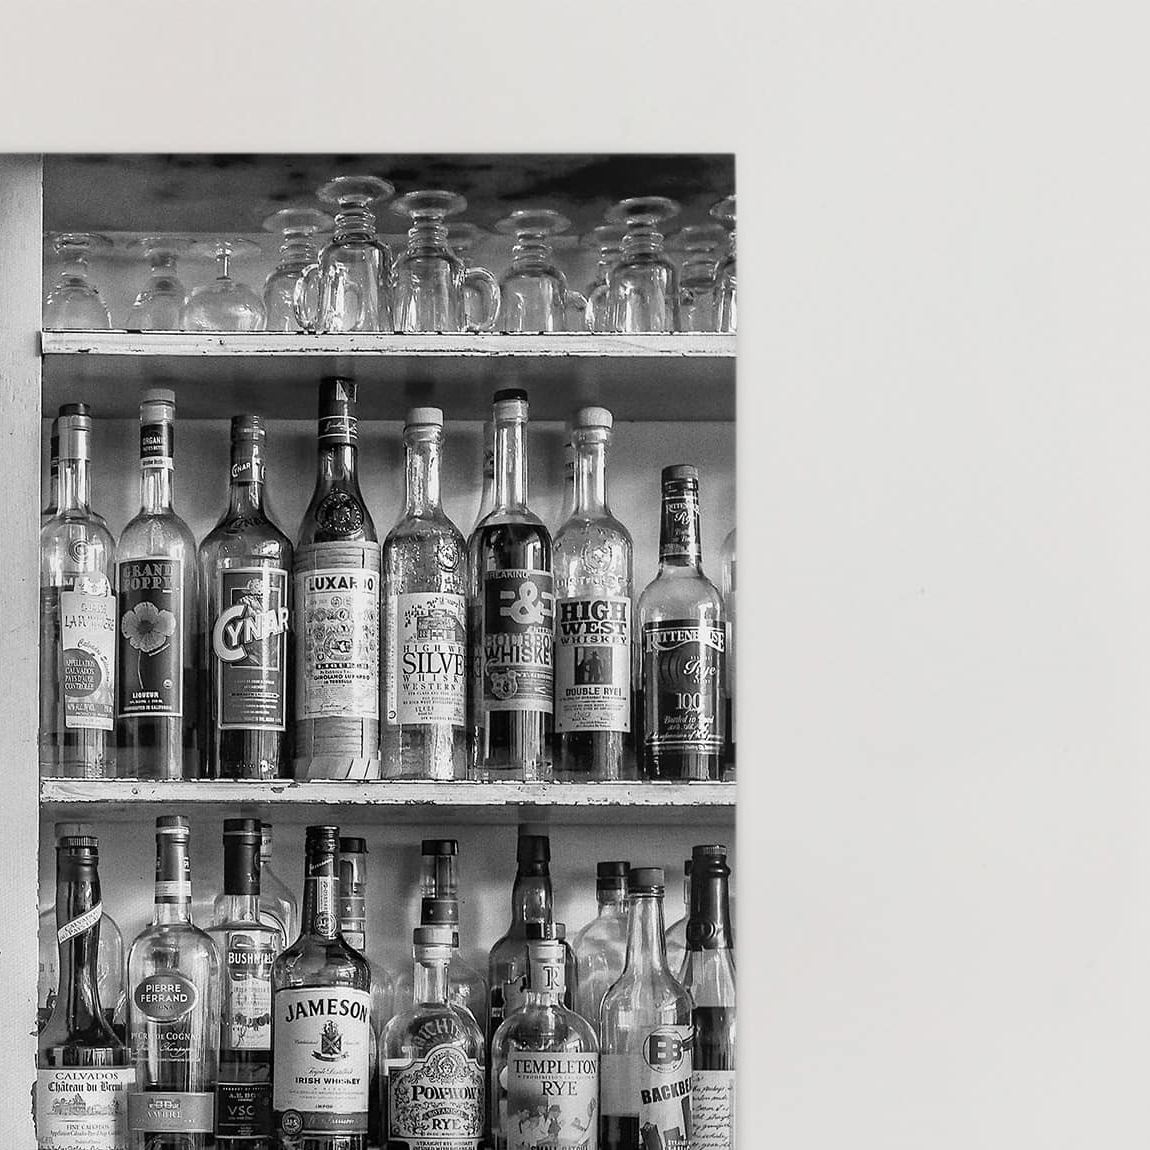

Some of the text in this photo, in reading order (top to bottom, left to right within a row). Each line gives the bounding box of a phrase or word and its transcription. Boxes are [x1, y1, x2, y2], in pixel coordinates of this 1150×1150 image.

[123, 563, 174, 578] GRAND
[309, 576, 374, 592] LUXARO
[560, 600, 627, 622] HIGH
[212, 603, 290, 664] CYNAR
[560, 621, 627, 636] WEST
[560, 635, 628, 646] WHISKEY
[403, 644, 441, 653] HIGH
[401, 651, 464, 677] SILVE
[402, 682, 456, 691] WESTERN
[565, 687, 600, 697] DOUBLE
[674, 692, 703, 711] 100
[145, 983, 182, 993] PIERRE
[140, 993, 188, 1003] FERRAND
[285, 998, 368, 1024] JAMESON
[514, 1059, 597, 1074] TEMPLETON
[55, 1072, 119, 1080] CALVADOS
[295, 1077, 321, 1085] IRISH
[48, 1080, 84, 1093] Château
[86, 1081, 97, 1091] du
[541, 1080, 578, 1096] RYE
[432, 1118, 462, 1130] RYE
